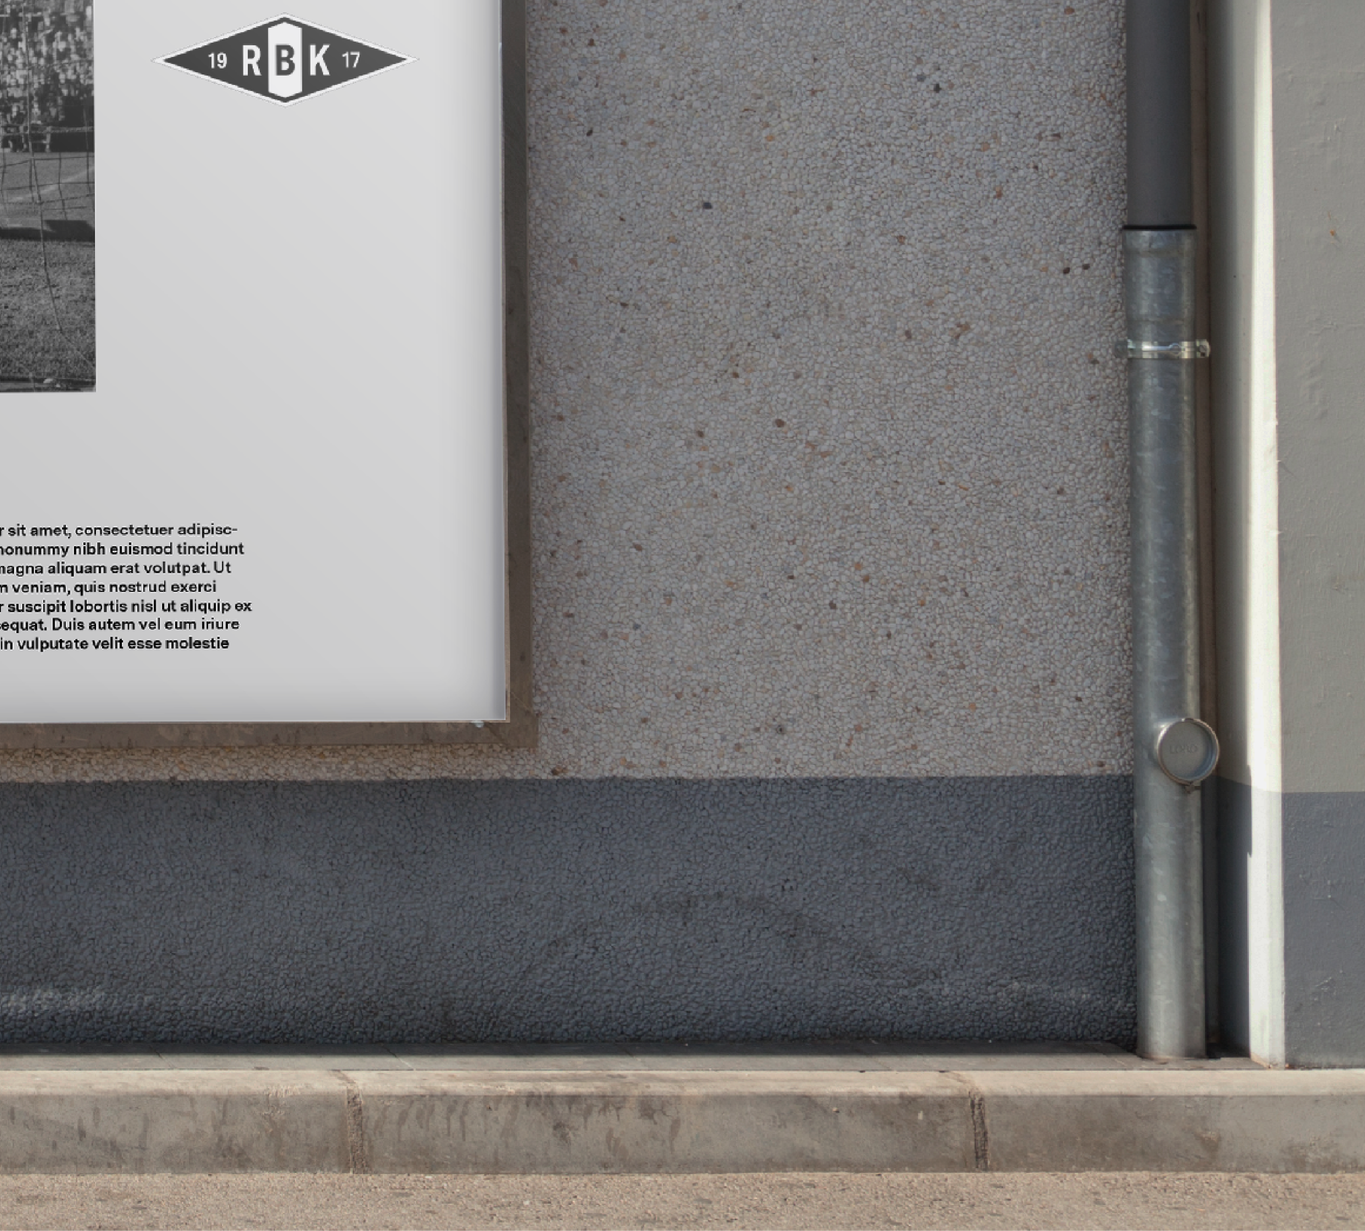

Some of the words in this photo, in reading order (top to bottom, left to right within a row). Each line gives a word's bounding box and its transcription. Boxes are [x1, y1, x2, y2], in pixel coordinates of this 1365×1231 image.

[208, 52, 228, 69] 19
[242, 44, 330, 76] RBK
[342, 51, 361, 68] 17
[8, 523, 26, 536] sit
[30, 525, 71, 539] amet,
[75, 525, 174, 536] consectetuer
[177, 523, 237, 538] adipisc-
[74, 542, 105, 555] nibh
[110, 542, 172, 555] euismod
[177, 542, 244, 555] tincidunt
[48, 561, 107, 577] aliquam
[110, 563, 140, 573] erat
[144, 561, 210, 576] volutpat.
[214, 561, 231, 573] Ut
[12, 581, 70, 596] veniam,
[74, 581, 105, 596] quis
[110, 580, 166, 592] nostrud
[171, 580, 216, 592] exerci
[8, 600, 66, 615] suscipit
[70, 600, 128, 612] lobortis
[131, 599, 156, 612] nisl
[162, 600, 177, 612] ut
[181, 599, 231, 614] aliquip
[235, 603, 252, 611] ex
[52, 618, 85, 631] Duis
[89, 619, 135, 630] autem
[138, 618, 160, 630] vel
[164, 621, 196, 630] eum
[202, 618, 239, 630] iriure
[1, 637, 13, 650] in
[17, 637, 89, 652] vulputate
[92, 637, 123, 649] velit
[128, 640, 162, 649] esse
[165, 637, 229, 649] molestie
